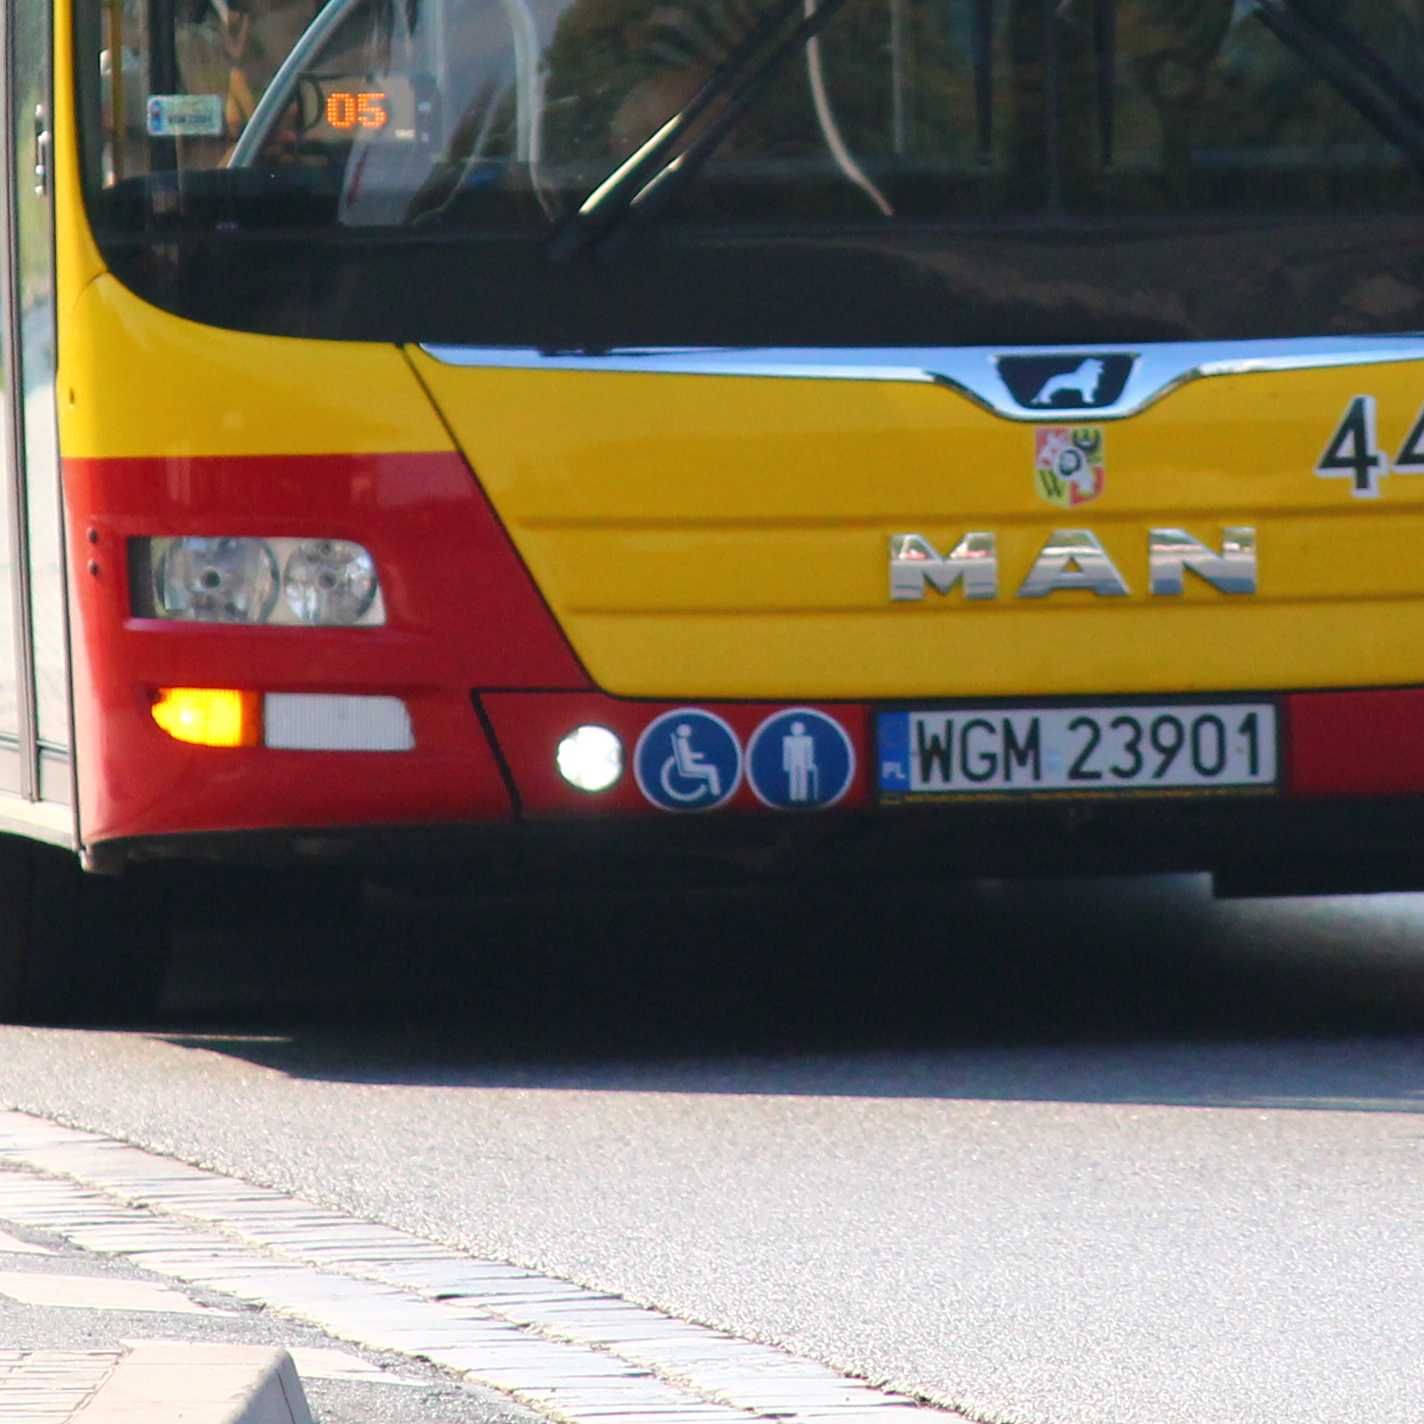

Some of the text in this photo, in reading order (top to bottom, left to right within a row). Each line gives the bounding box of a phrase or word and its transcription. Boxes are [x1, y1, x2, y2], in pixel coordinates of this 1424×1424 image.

[327, 92, 388, 128] 05
[889, 527, 1258, 601] MAN
[916, 712, 1259, 784] WGM 23901
